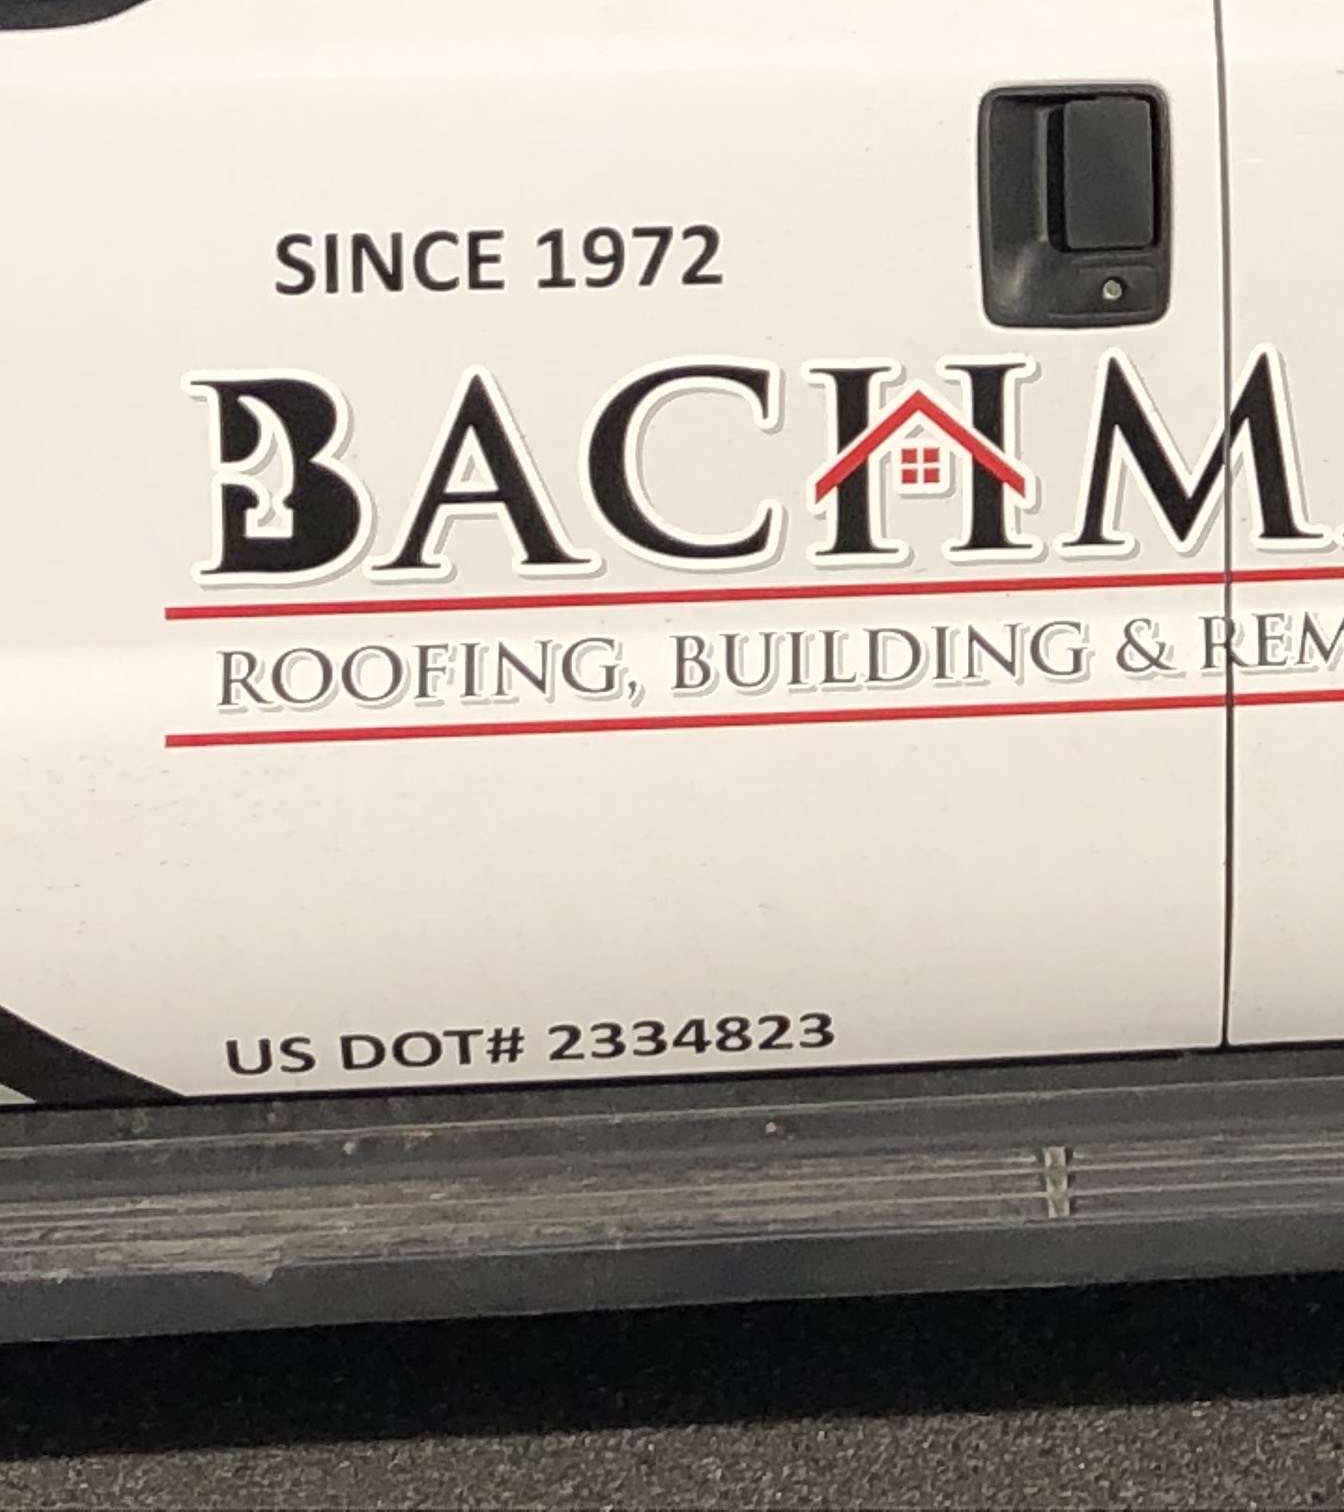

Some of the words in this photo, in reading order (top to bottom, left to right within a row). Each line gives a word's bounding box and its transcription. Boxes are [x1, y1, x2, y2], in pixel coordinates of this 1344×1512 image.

[276, 231, 504, 295] SINCE
[538, 225, 723, 288] 1972
[217, 640, 644, 706] ROOFING,
[672, 622, 1083, 691] BUILDING
[1115, 619, 1170, 673] &
[226, 1037, 316, 1075] US
[340, 1027, 526, 1071] DOT#
[547, 1012, 836, 1061] 2334823
